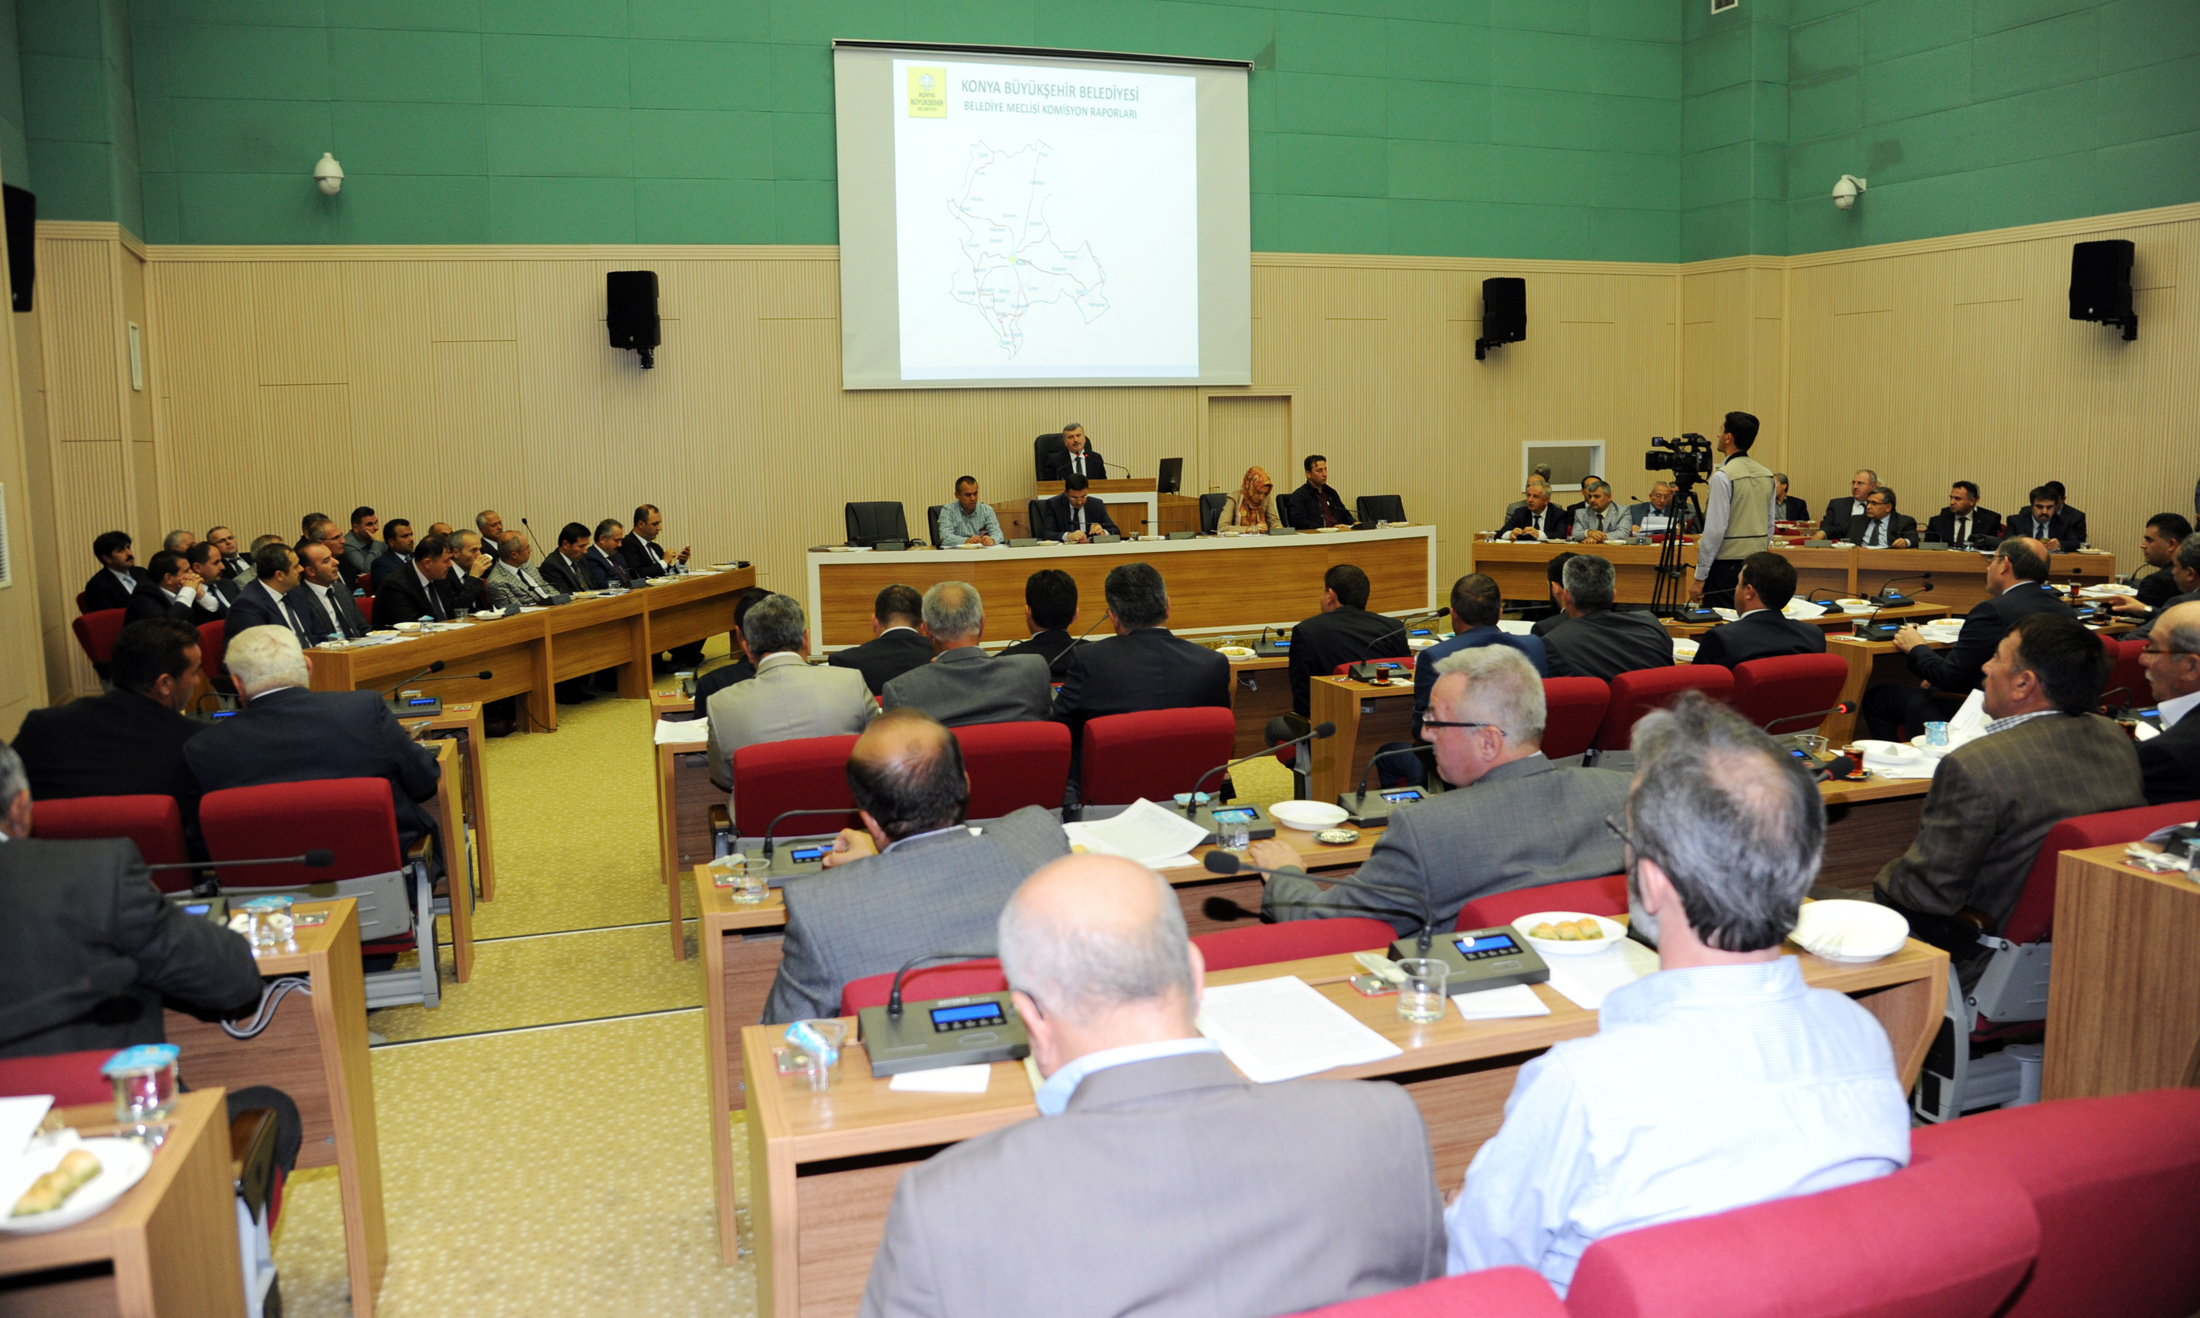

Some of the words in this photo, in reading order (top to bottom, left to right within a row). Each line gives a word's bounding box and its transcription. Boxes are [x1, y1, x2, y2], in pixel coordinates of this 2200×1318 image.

[961, 79, 1001, 93] KONYA
[1004, 78, 1076, 99] BÜYÜKŞEHİR
[1079, 84, 1139, 101] BELEDİYESİ
[964, 99, 1004, 112] BELEDİYE
[1006, 101, 1040, 114] MECLİSİ
[1042, 103, 1088, 116] KOMİSYON
[1090, 107, 1137, 119] RAPORLARI
